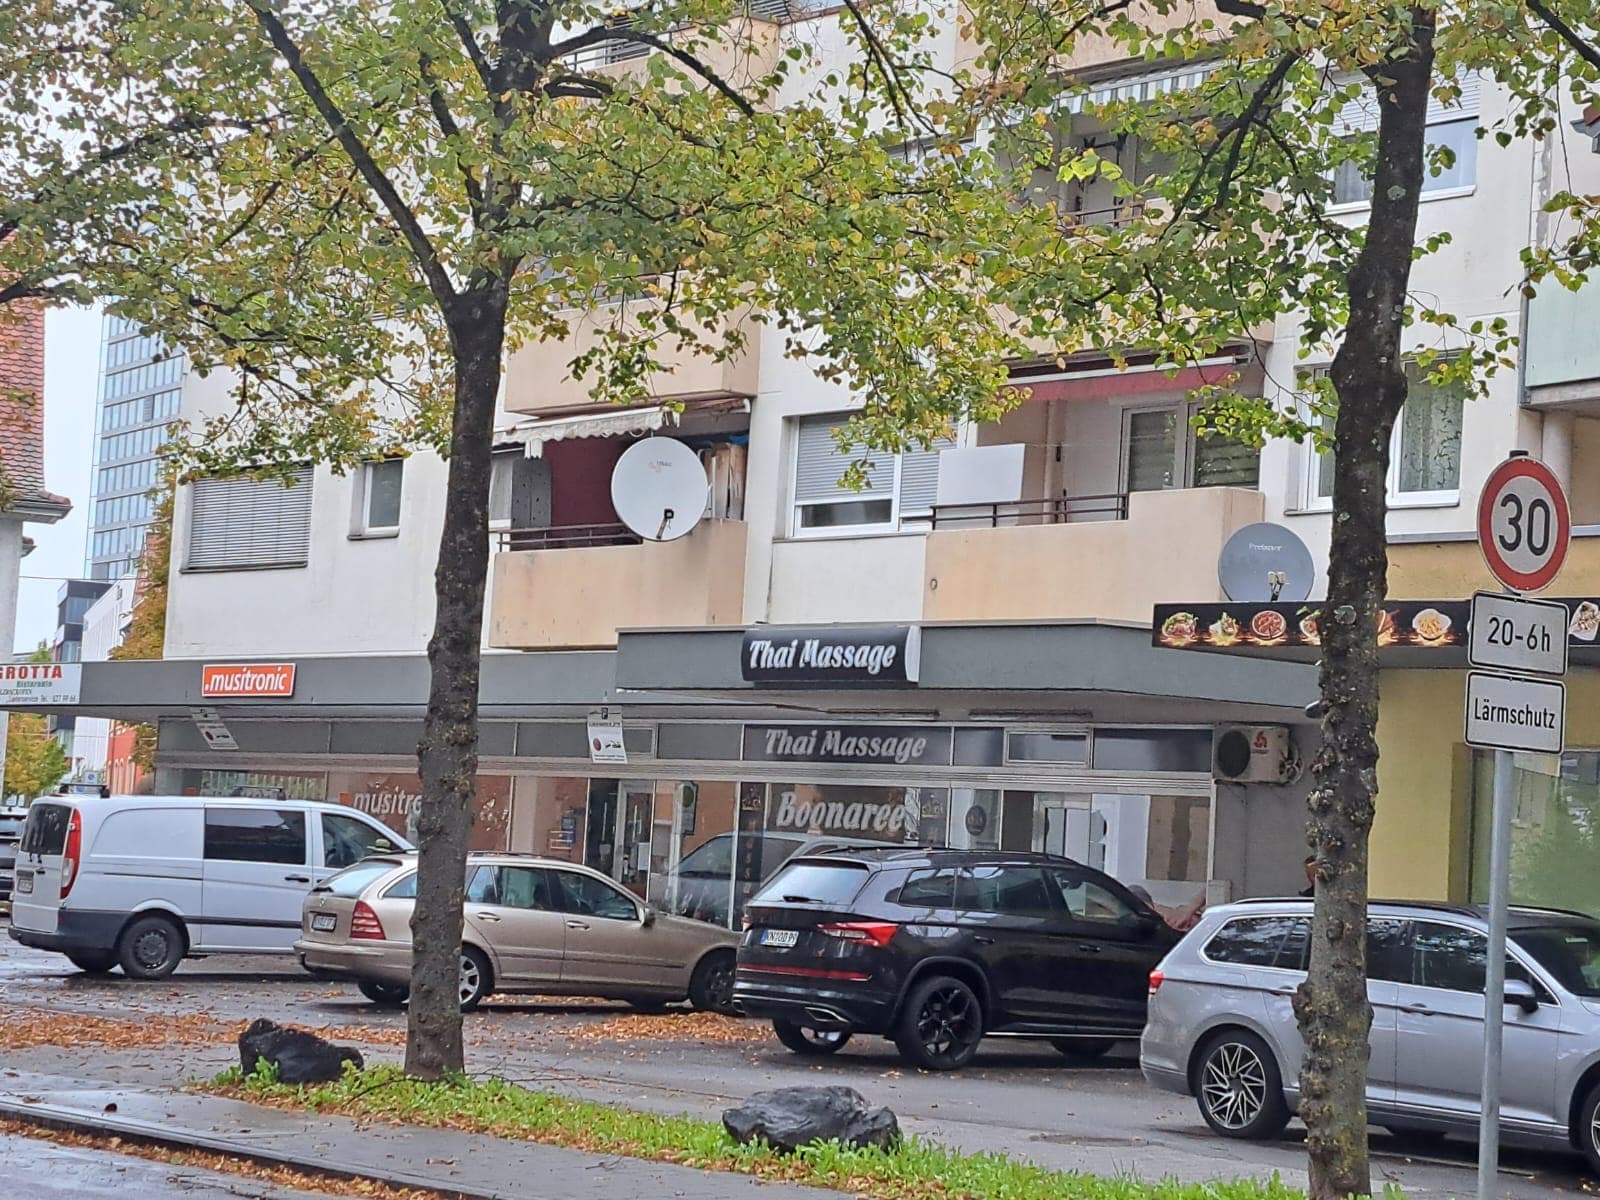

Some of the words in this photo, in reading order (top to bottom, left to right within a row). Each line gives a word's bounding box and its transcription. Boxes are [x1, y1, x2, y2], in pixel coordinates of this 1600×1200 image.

[1499, 493, 1550, 556] 30
[1487, 616, 1551, 653] 20-6h
[749, 639, 798, 669] Thai
[799, 639, 896, 675] Massage
[1474, 697, 1556, 729] Lärmschutz
[765, 728, 818, 755] Thai
[820, 729, 927, 764] Massage
[352, 785, 422, 815] musitro
[775, 790, 906, 833] Boonaree
